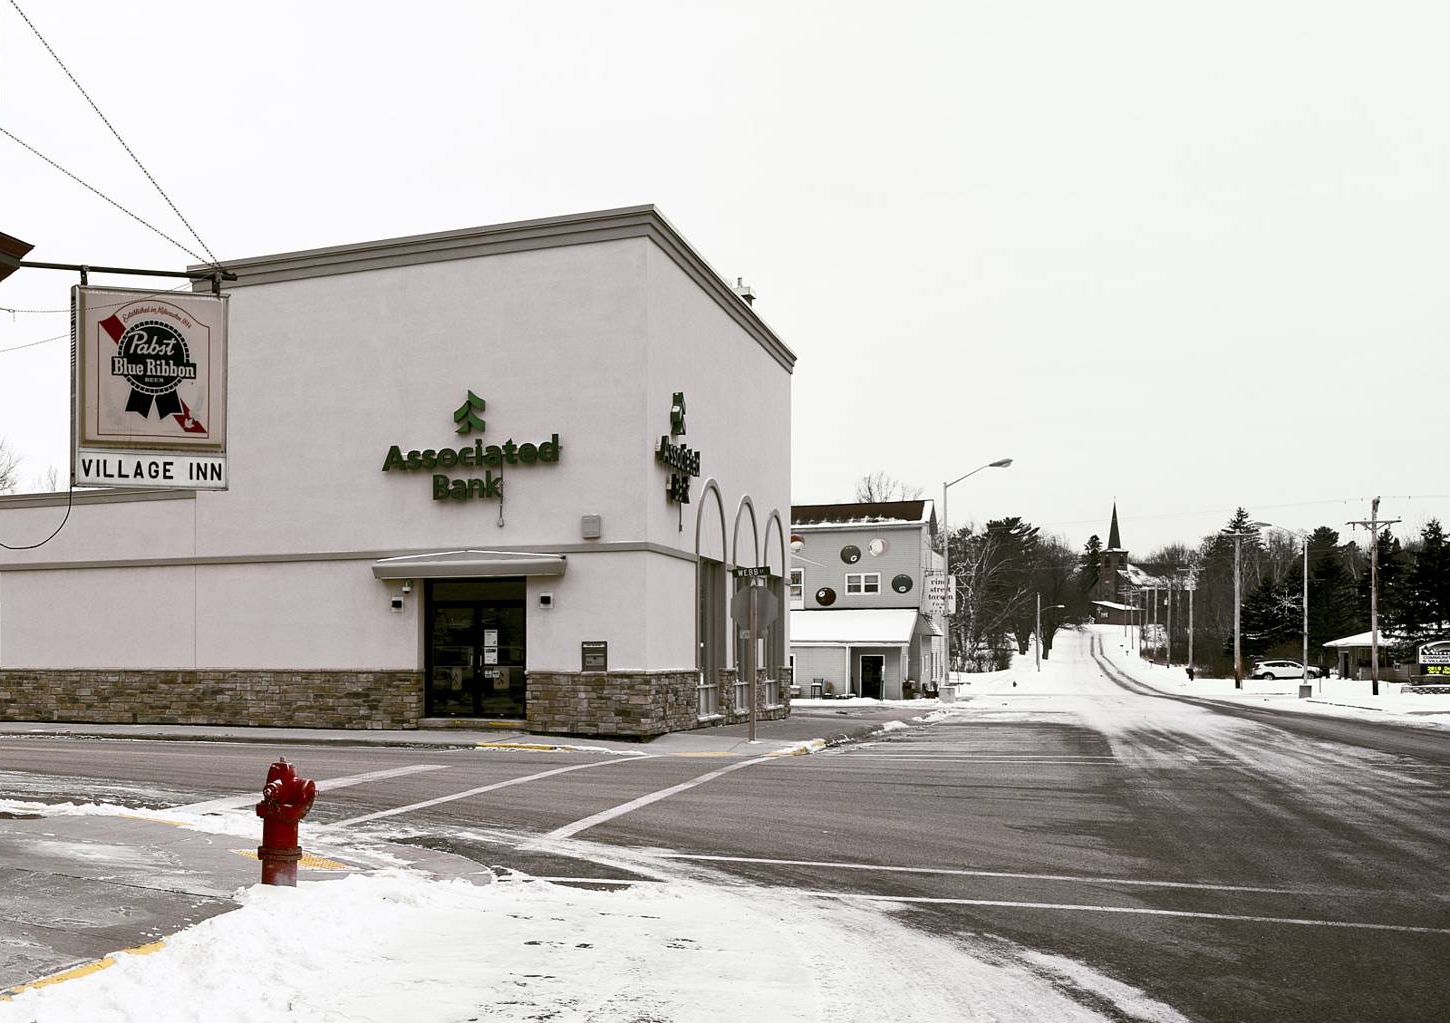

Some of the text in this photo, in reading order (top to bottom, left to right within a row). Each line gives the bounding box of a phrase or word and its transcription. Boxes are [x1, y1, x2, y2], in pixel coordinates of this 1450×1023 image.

[127, 330, 177, 356] Pabst
[113, 357, 195, 378] Blue Ribbon
[382, 433, 560, 472] Associated
[81, 458, 223, 481] VILLAGE INN
[432, 470, 502, 501] Bank
[737, 568, 759, 577] WEBB
